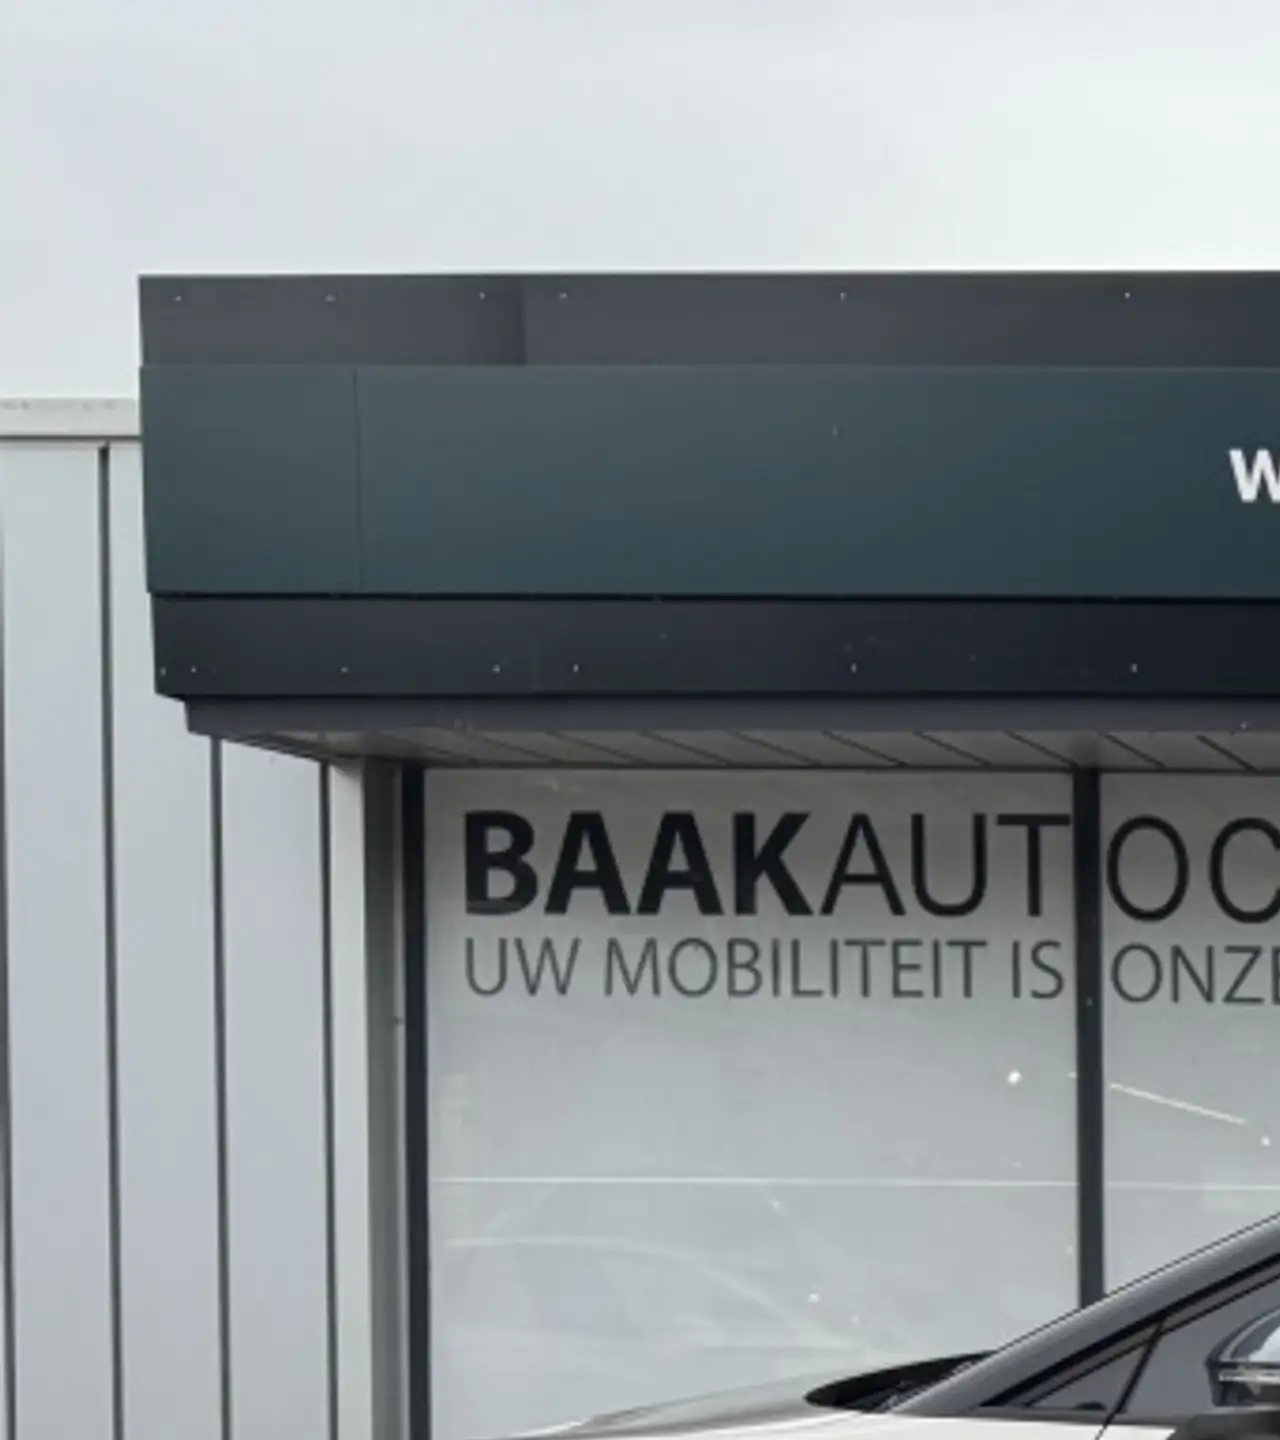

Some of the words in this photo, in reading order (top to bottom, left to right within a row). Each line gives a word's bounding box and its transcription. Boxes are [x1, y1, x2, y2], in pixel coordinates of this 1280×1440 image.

[465, 936, 582, 997] UW
[604, 936, 990, 999] MOBILITEIT
[1011, 939, 1065, 999] IS
